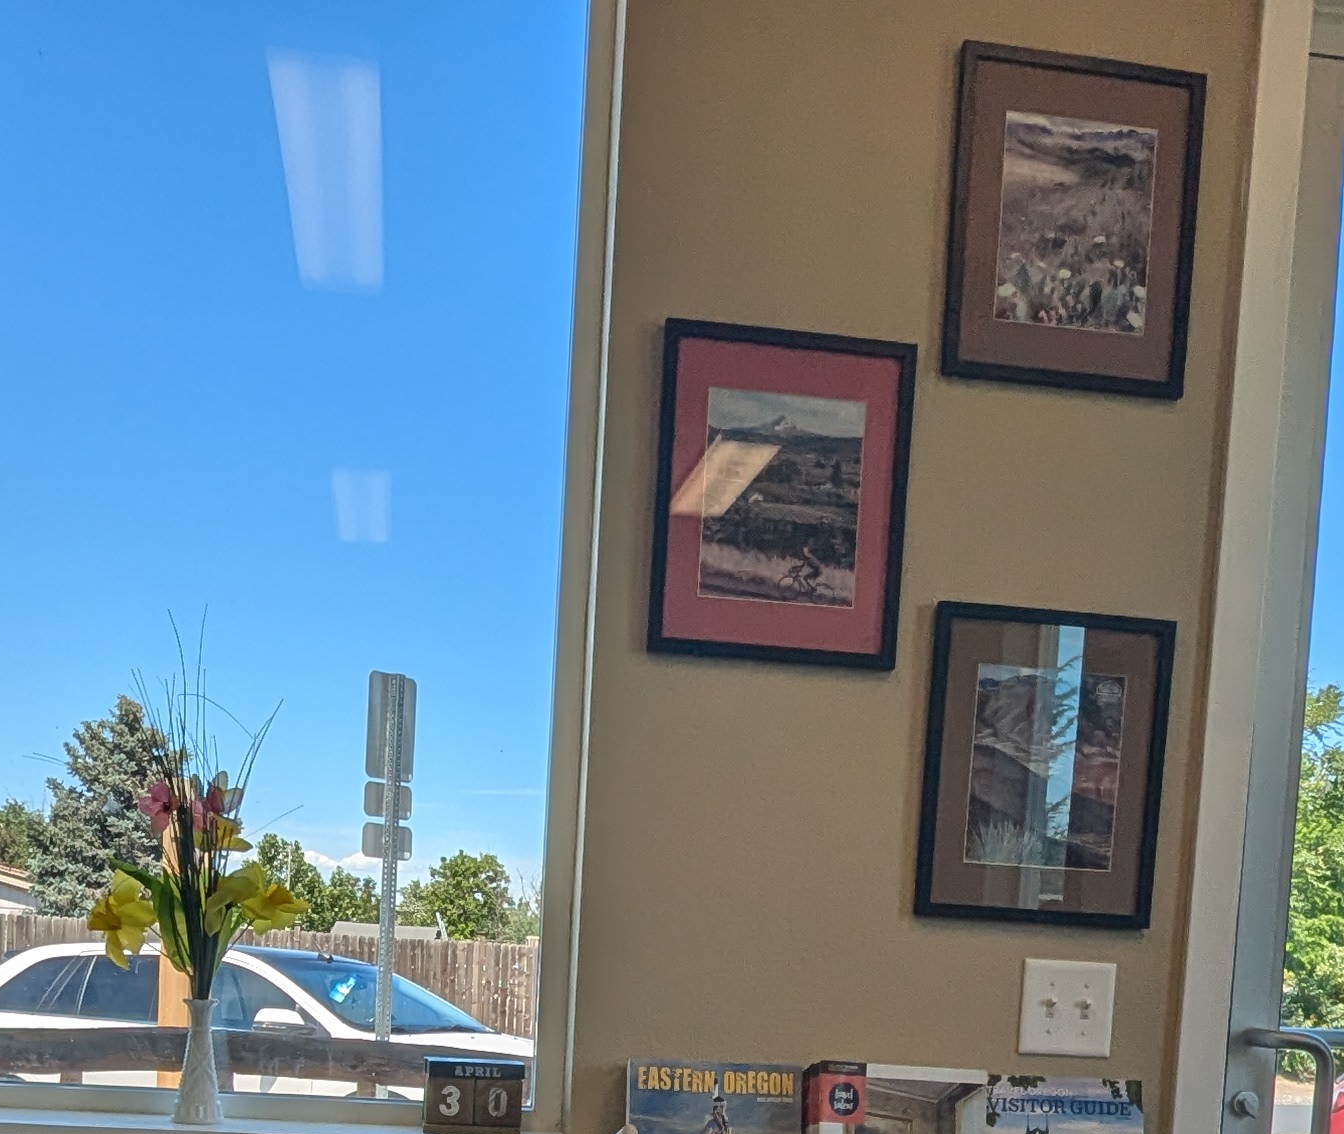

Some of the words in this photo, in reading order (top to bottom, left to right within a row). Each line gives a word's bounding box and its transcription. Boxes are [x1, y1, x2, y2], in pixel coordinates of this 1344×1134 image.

[455, 1064, 502, 1079] APRIL
[637, 1066, 716, 1093] EASTERN
[723, 1071, 795, 1097] OREGON
[438, 1085, 461, 1117] 3
[487, 1087, 509, 1118] 0
[987, 1097, 1067, 1114] VISITOR
[1069, 1099, 1133, 1117] GUIDE
